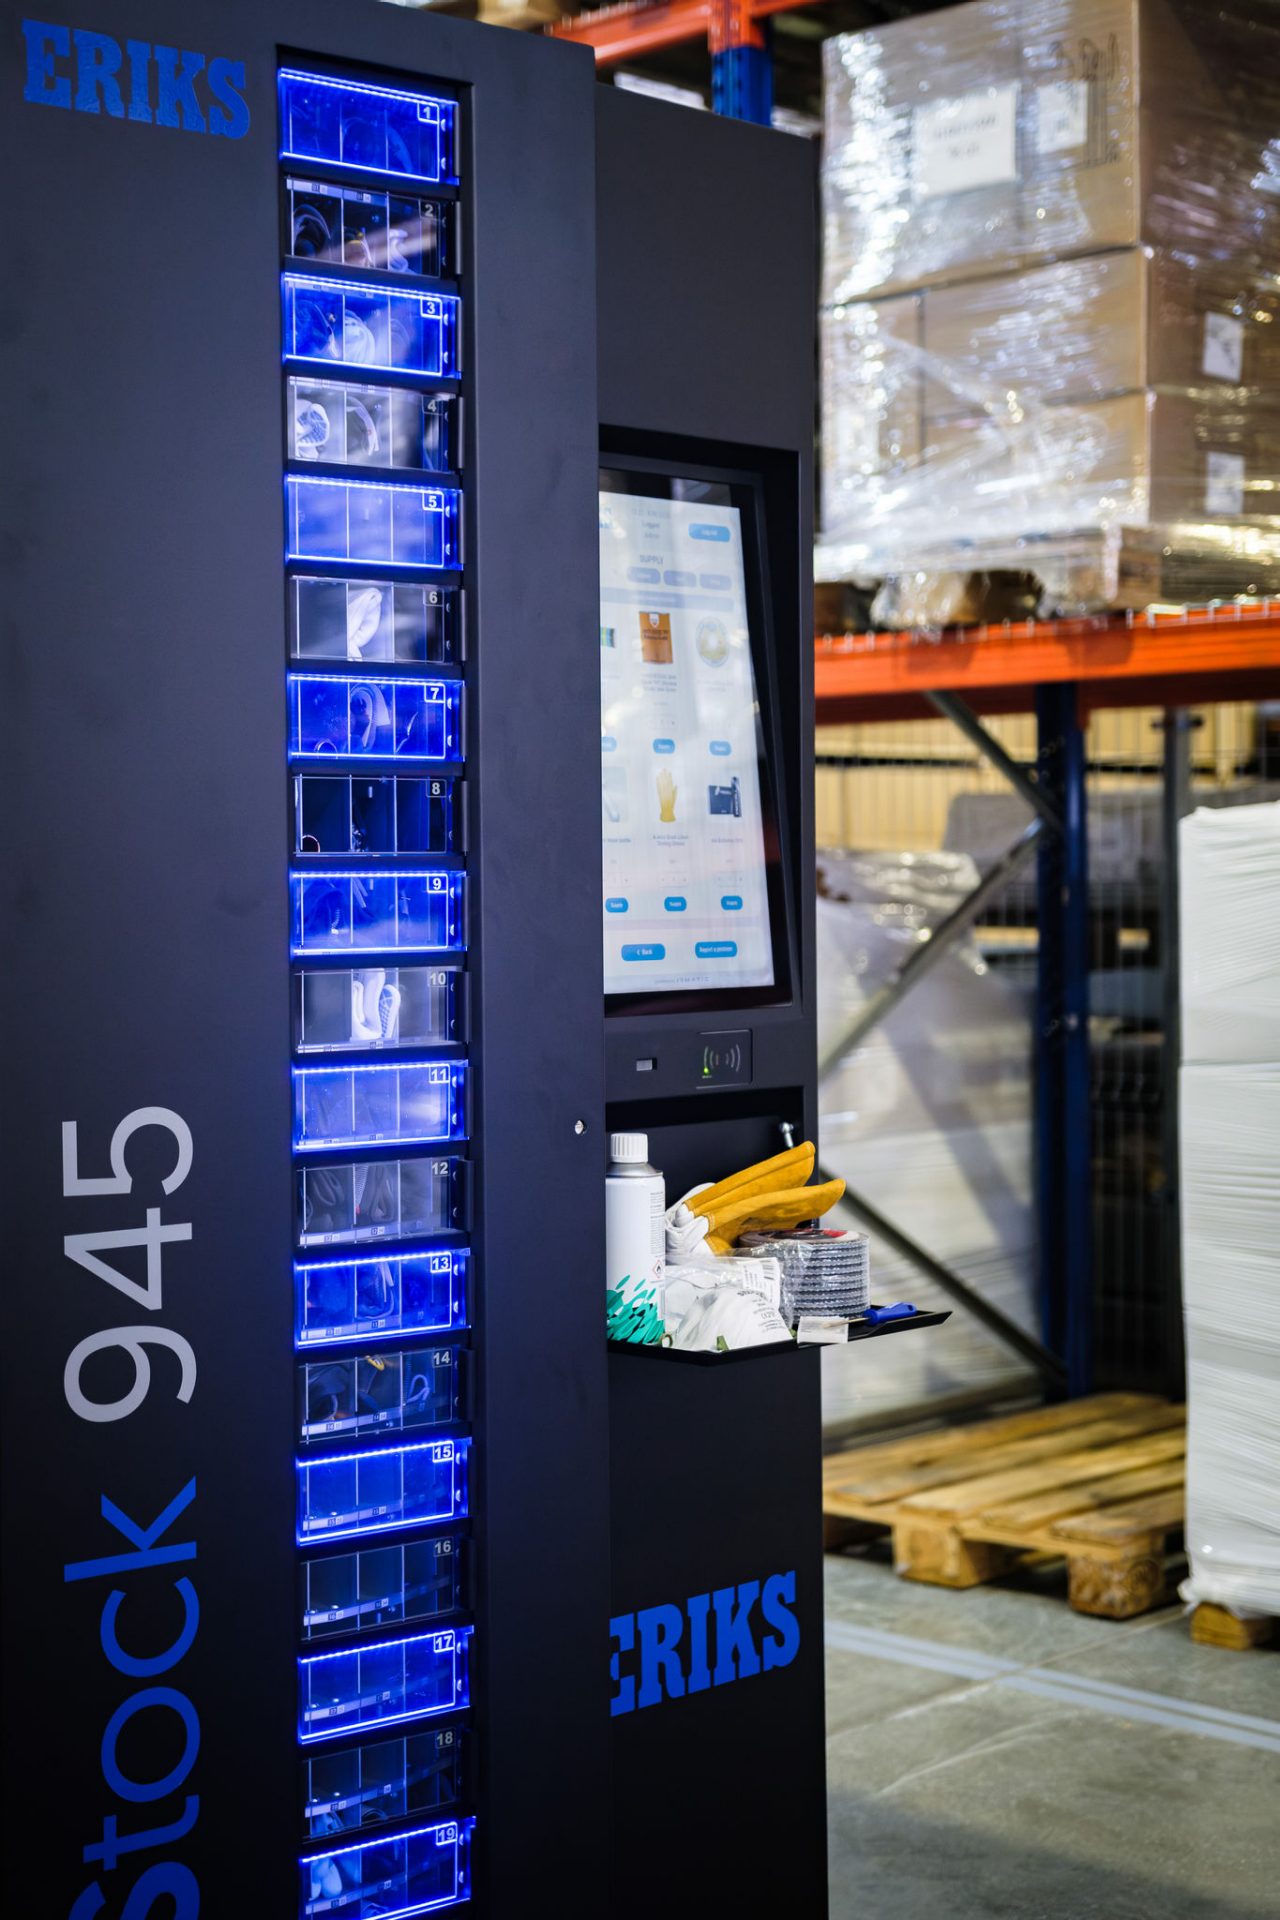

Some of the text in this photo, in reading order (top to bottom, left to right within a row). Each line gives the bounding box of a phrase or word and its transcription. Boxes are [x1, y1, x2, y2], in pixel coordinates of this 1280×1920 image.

[22, 18, 250, 140] ERIKS
[423, 106, 431, 119] 1
[425, 204, 434, 217] 2
[426, 301, 435, 314] 3
[427, 400, 437, 412] 4
[428, 496, 437, 508] 5
[429, 591, 438, 604] 6
[430, 687, 440, 700] 7
[431, 782, 441, 795] 8
[432, 877, 442, 890] 9
[430, 972, 446, 986] 10
[431, 1068, 447, 1081] 11
[432, 1162, 448, 1175] 12
[62, 1106, 197, 1424] 945
[432, 1257, 449, 1270] 13
[433, 1351, 450, 1365] 14
[435, 1445, 452, 1459] 15
[435, 1540, 452, 1554] 16
[435, 1636, 453, 1650] 17
[436, 1731, 453, 1745] 18
[438, 1827, 455, 1841] 19
